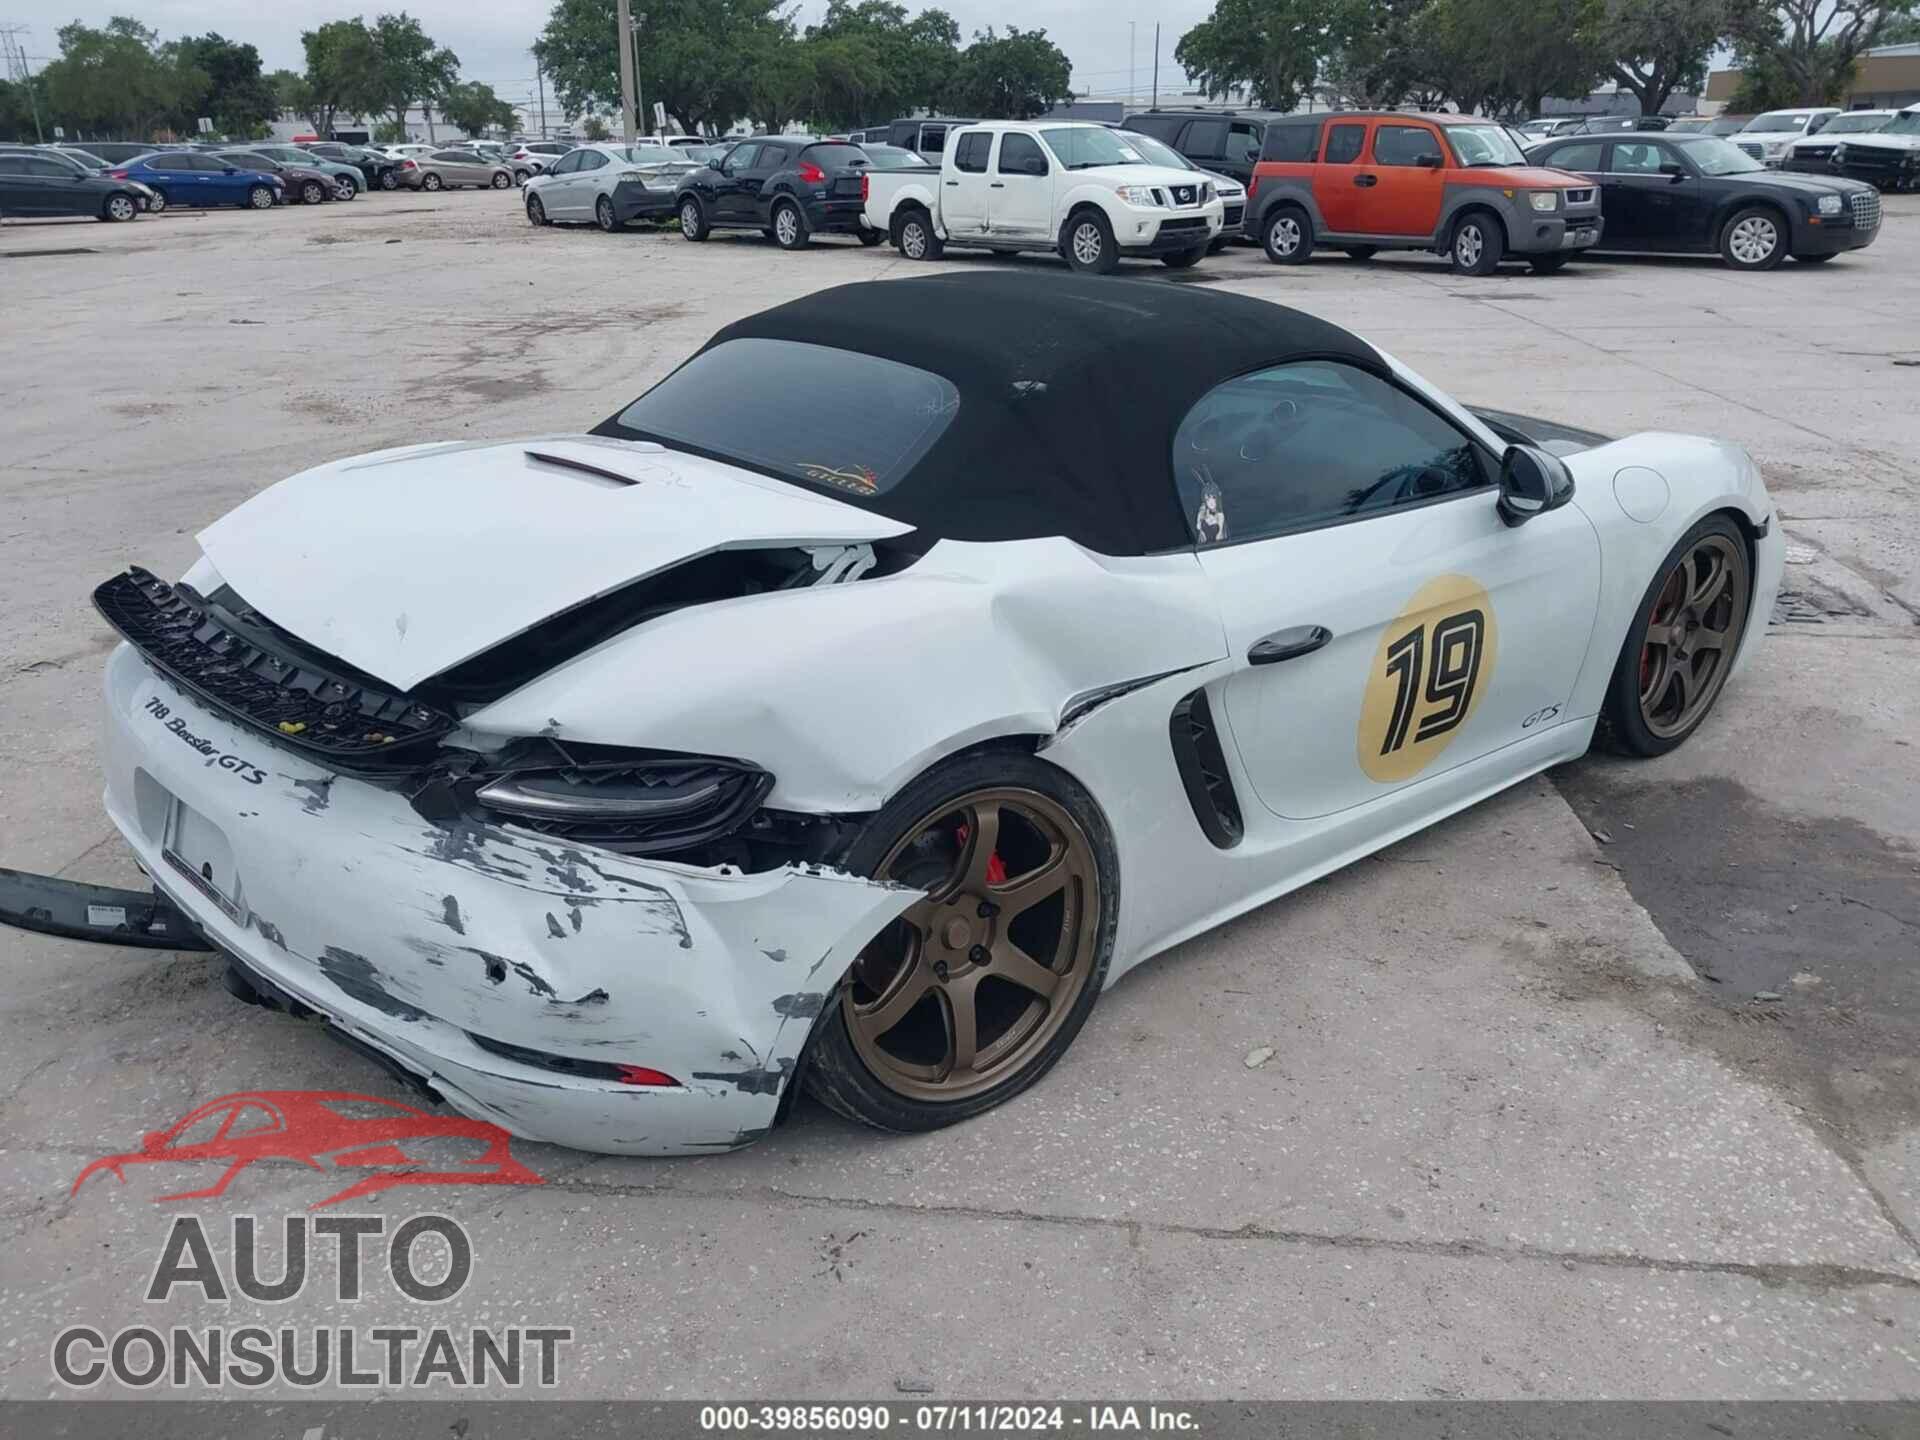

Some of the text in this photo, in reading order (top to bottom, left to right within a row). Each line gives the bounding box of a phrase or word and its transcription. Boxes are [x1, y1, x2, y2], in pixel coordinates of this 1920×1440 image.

[1379, 608, 1485, 757] 19
[1521, 702, 1562, 730] GTS
[144, 696, 268, 785] 718 Boxster GTS
